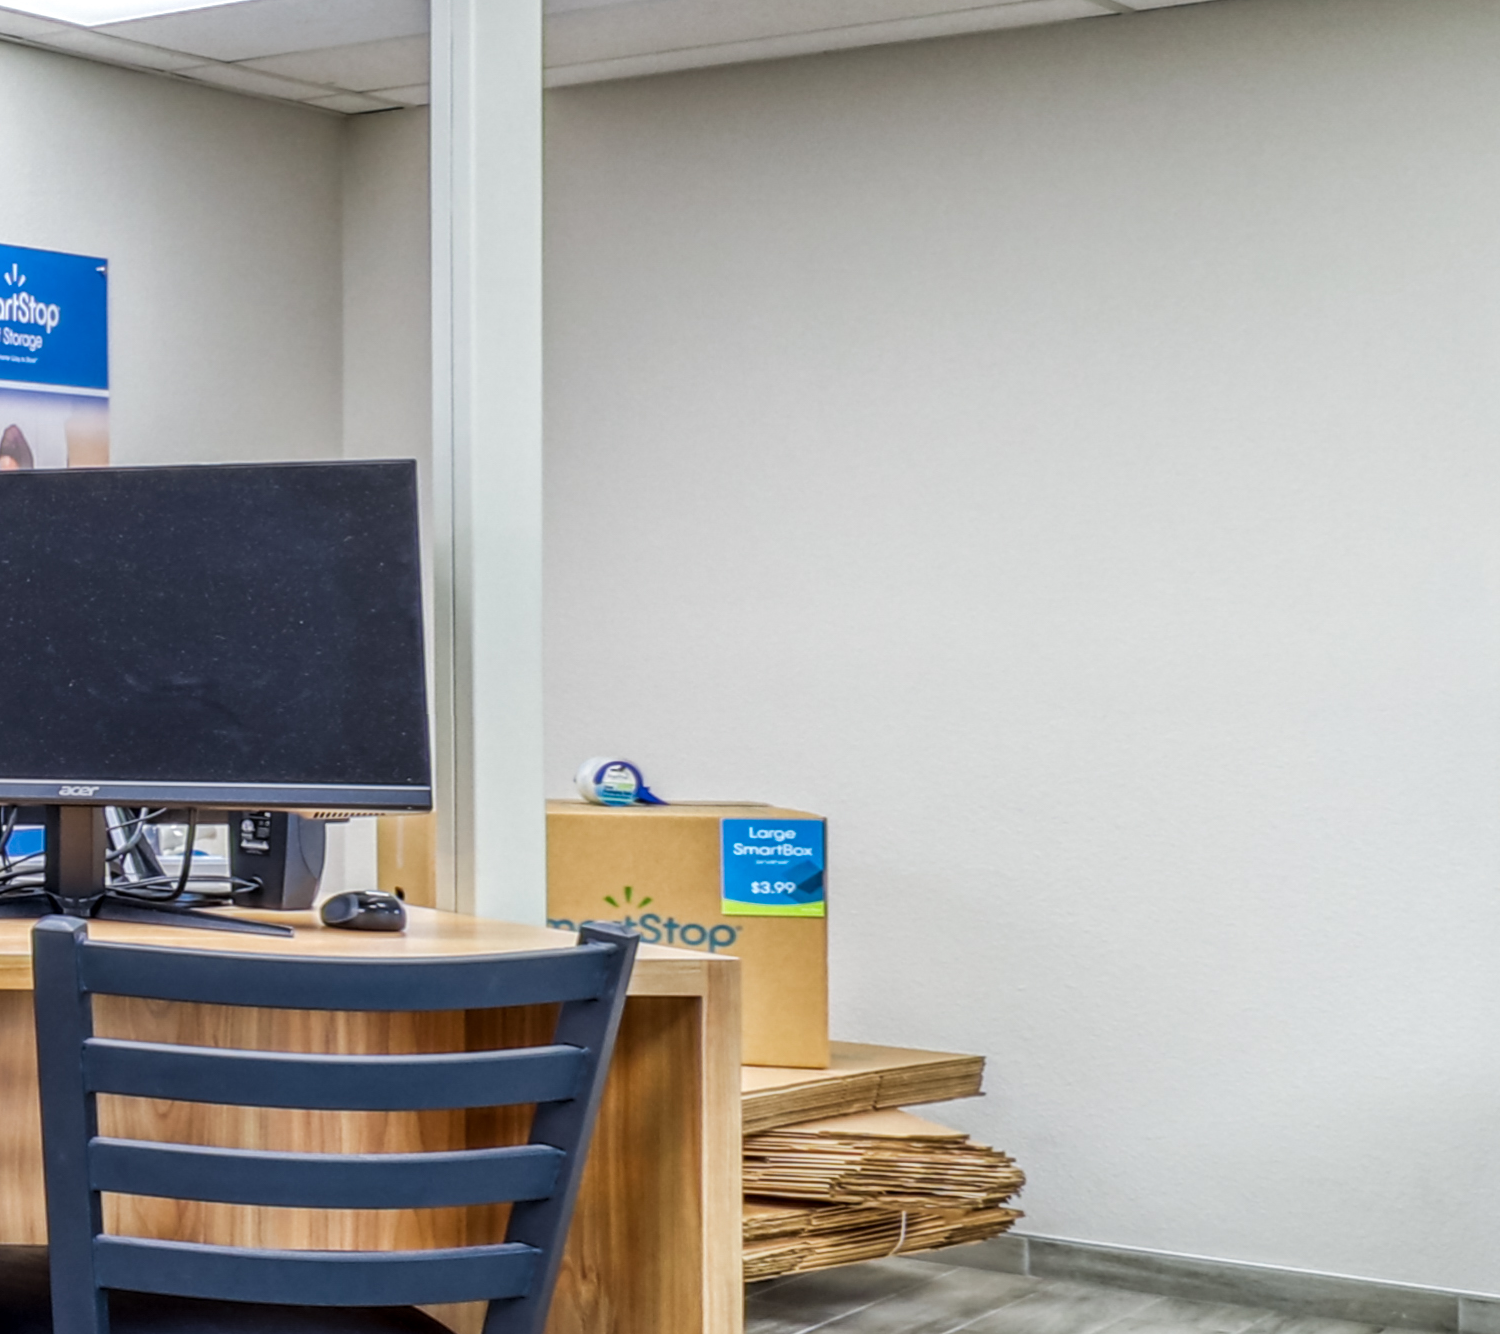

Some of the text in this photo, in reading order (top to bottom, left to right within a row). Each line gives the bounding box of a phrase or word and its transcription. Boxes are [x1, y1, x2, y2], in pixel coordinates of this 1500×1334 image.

[2, 326, 43, 352] Storage
[59, 785, 100, 796] acer
[748, 826, 797, 842] Large
[732, 842, 813, 857] SmartBox
[750, 880, 797, 895] $3.99
